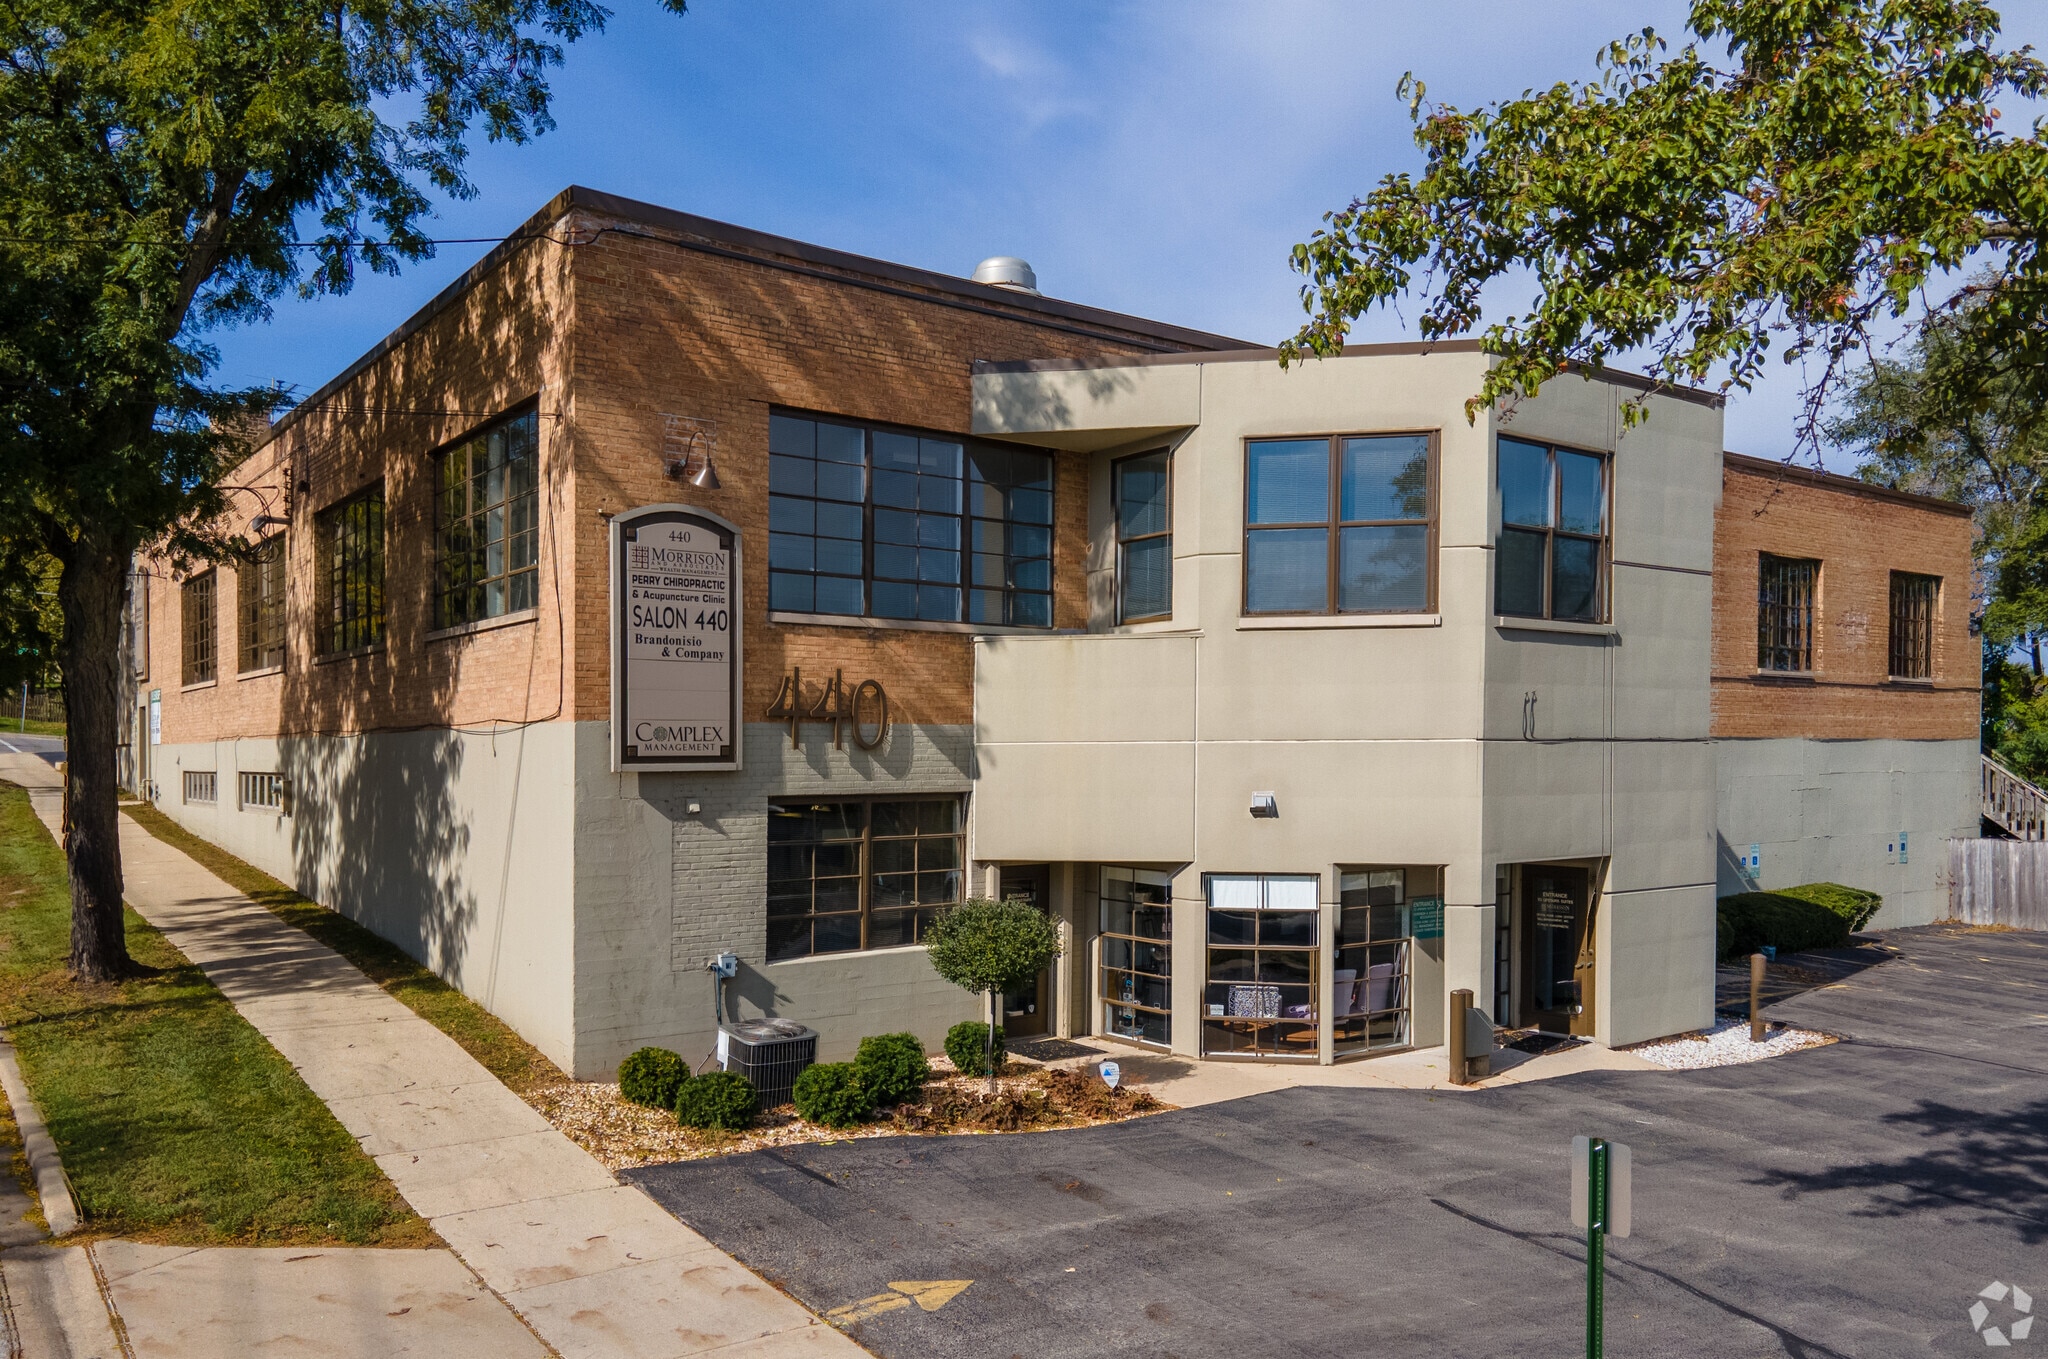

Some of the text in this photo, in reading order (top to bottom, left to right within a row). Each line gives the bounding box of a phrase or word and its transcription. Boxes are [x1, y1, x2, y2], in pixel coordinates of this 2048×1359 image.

[668, 530, 691, 543] 440
[651, 547, 726, 566] MORRISON
[673, 562, 725, 571] ASSOCIATES
[681, 568, 718, 576] MANAGEMENT
[632, 574, 725, 590] PERRY CHIROPRACTIC
[632, 590, 725, 604] & Acupuncture Clinic
[633, 605, 728, 631] SALON 440
[635, 633, 702, 647] Brandonisio
[661, 646, 724, 661] & Company
[766, 666, 888, 751] 440
[635, 722, 723, 742] COMPLEX
[644, 743, 716, 752] MANAGEMENT
